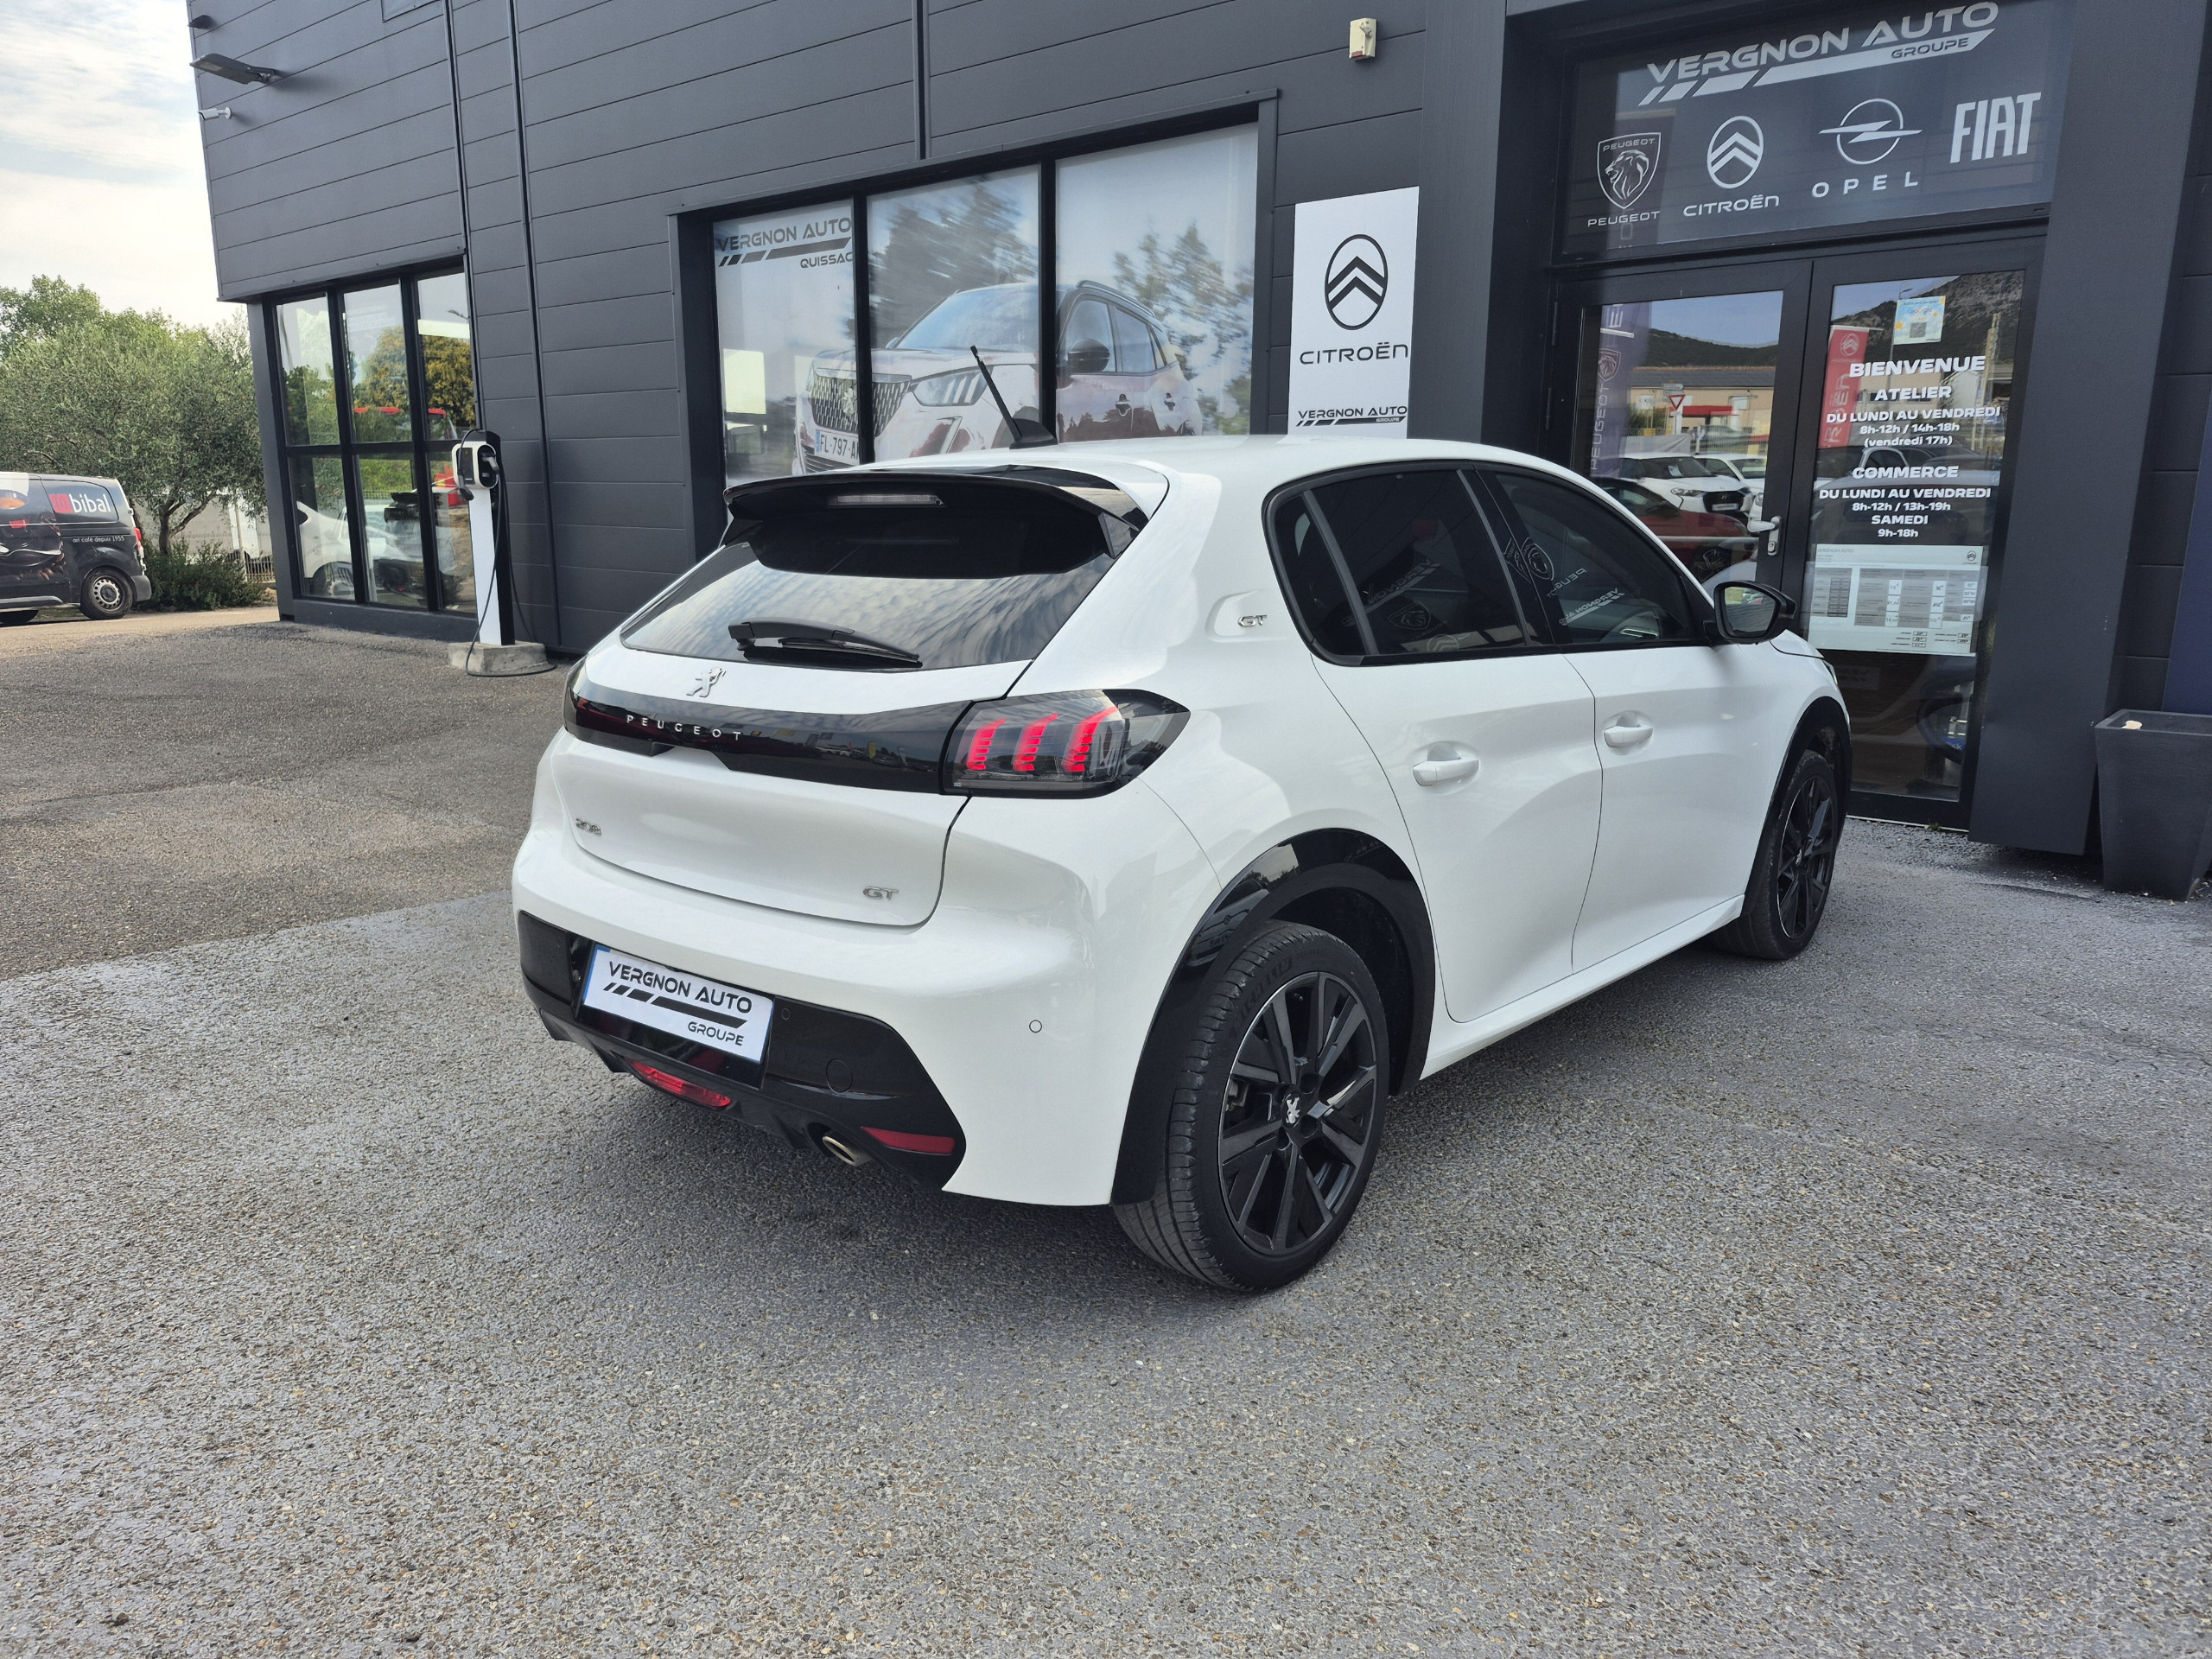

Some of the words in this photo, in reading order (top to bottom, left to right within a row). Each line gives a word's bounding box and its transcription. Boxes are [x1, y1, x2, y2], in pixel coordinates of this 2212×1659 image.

[1647, 27, 1850, 84] VERGNON
[1861, 3, 1999, 48] AUTO
[1891, 38, 1970, 59] GROUPE
[1949, 92, 2042, 164] FIAT
[1603, 138, 1656, 152] PEUGEOT
[1811, 171, 1918, 198] OPEL
[1587, 211, 1660, 227] PEUGEOT
[717, 226, 797, 252] VERGNON
[803, 217, 852, 240] AUTO
[800, 251, 853, 269] QUISSAC
[1849, 355, 1986, 378] BIENVENUE
[1874, 385, 1952, 401] ATELIER
[1298, 408, 1363, 419] VERGNON
[1368, 405, 1408, 416] AUTO
[1827, 412, 1847, 423] DU
[1849, 410, 1893, 422] LUNDI
[1896, 410, 1919, 421] AU
[1922, 406, 2000, 419] VENDREDI
[1859, 424, 1900, 434] 8h-12h
[1911, 423, 1960, 433] 14h-18h
[1864, 436, 1923, 448] (vendredi
[1926, 435, 1953, 446] 17h)
[1852, 466, 1959, 479] COMMERCE
[1819, 489, 1840, 499] DU
[1842, 489, 1885, 499] LUNDI
[1888, 488, 1910, 499] AU
[1912, 488, 1991, 499] VENDREDI
[69, 493, 111, 513] bibal
[1852, 502, 1892, 512] 8h-12h
[1903, 501, 1951, 512] 13h-19h
[1871, 515, 1929, 524] SAMEDI
[1878, 529, 1918, 537] 9h-18h
[1236, 613, 1268, 628] GT
[626, 715, 741, 741] PEUGEOT
[575, 817, 601, 836] 208
[862, 885, 899, 900] GT
[609, 961, 691, 997] VERGNON
[695, 986, 752, 1014] AUTO
[688, 1021, 745, 1046] GROUPE
